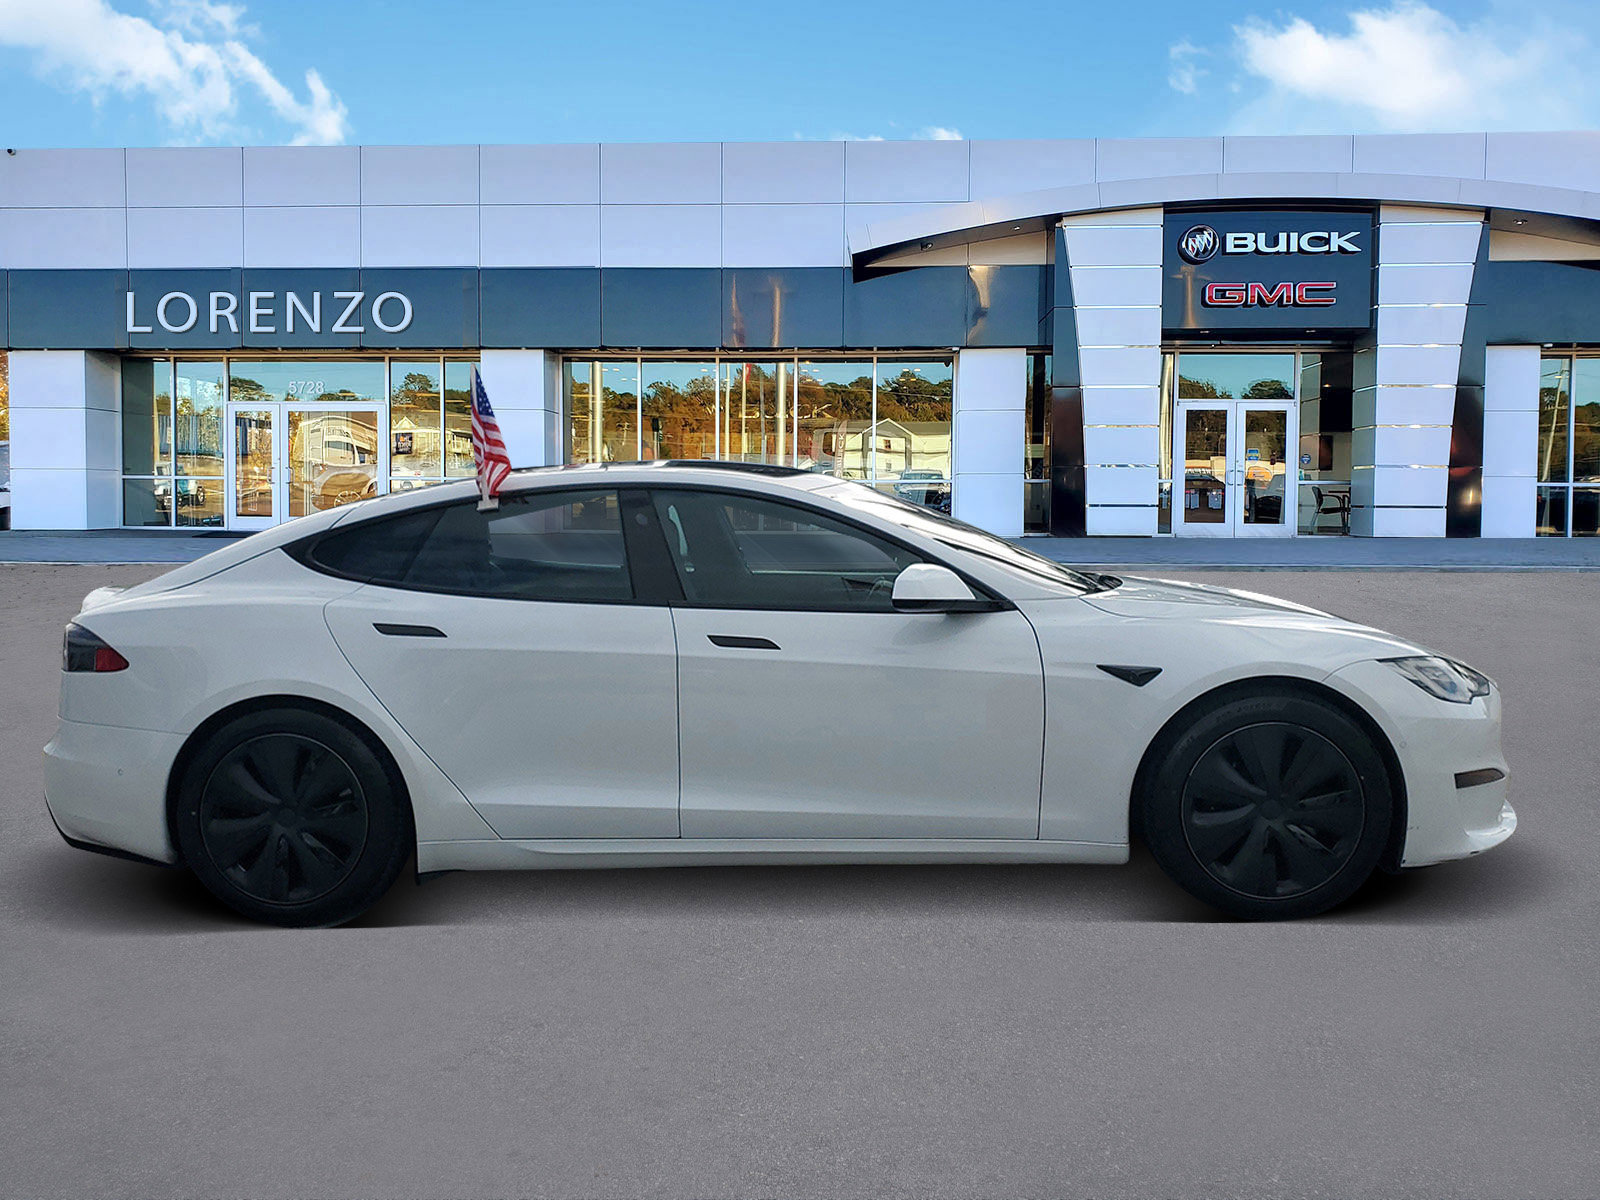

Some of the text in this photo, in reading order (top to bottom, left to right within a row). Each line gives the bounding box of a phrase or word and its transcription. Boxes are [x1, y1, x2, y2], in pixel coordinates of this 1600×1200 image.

[1226, 232, 1361, 252] BUICK
[1206, 282, 1336, 305] GMC
[126, 291, 413, 333] LORENZO
[288, 381, 324, 394] 5728
